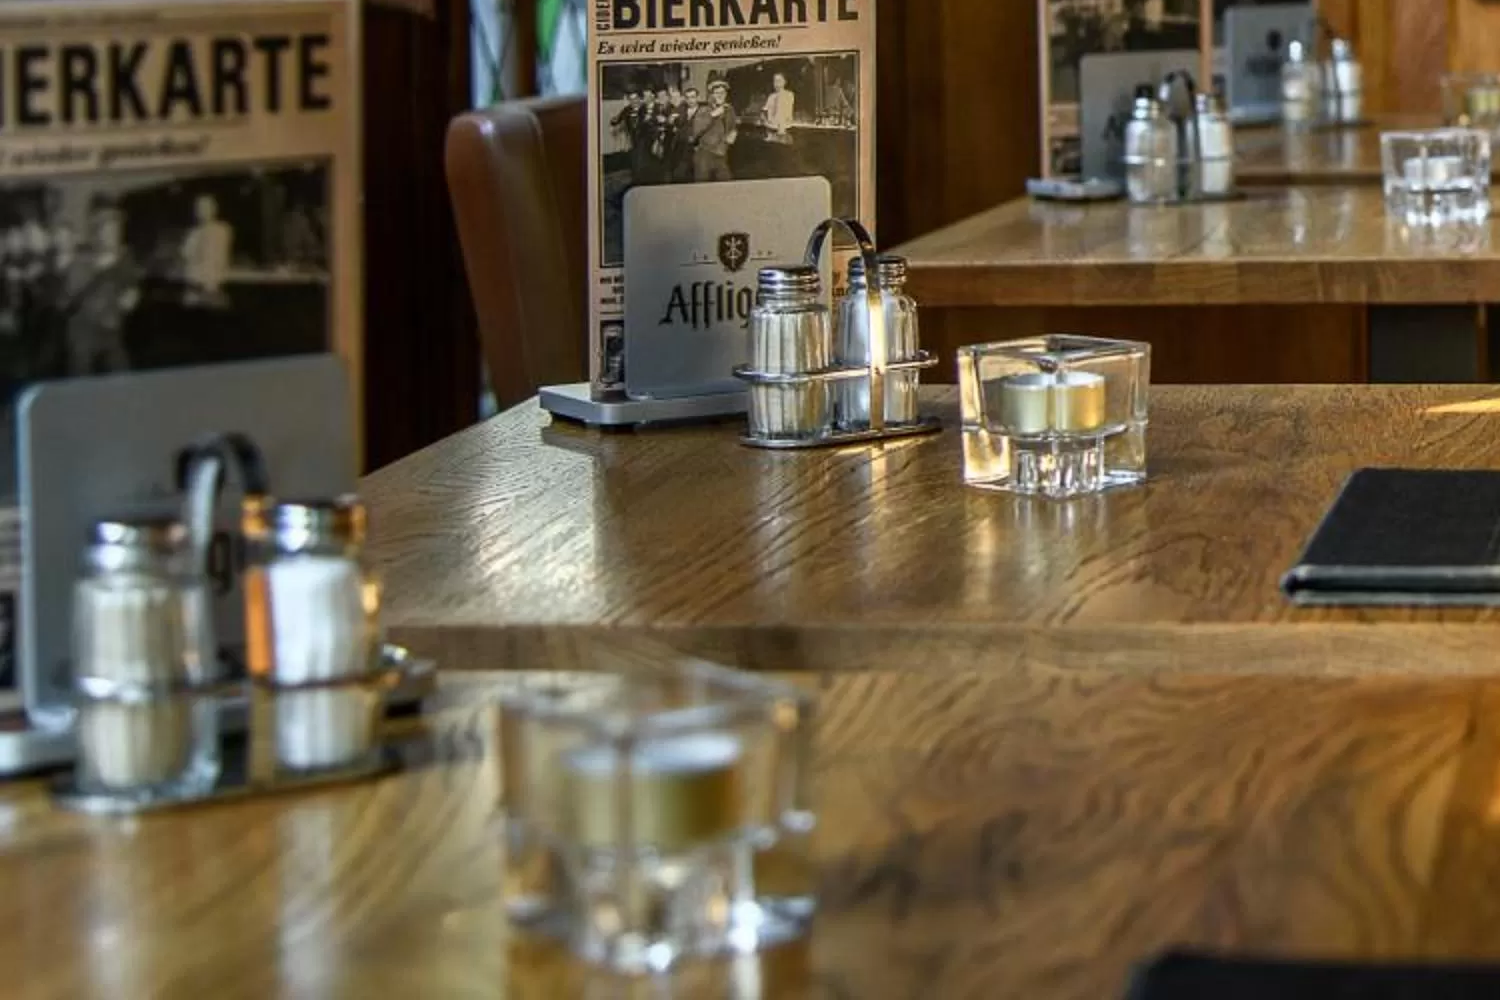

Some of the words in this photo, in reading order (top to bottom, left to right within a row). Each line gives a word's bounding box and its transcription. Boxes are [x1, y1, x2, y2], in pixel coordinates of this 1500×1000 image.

[597, 41, 615, 55] Es
[619, 38, 657, 54] wird
[659, 36, 711, 54] wieder
[0, 33, 332, 127] ERKARTE
[658, 280, 752, 329] Afflig
